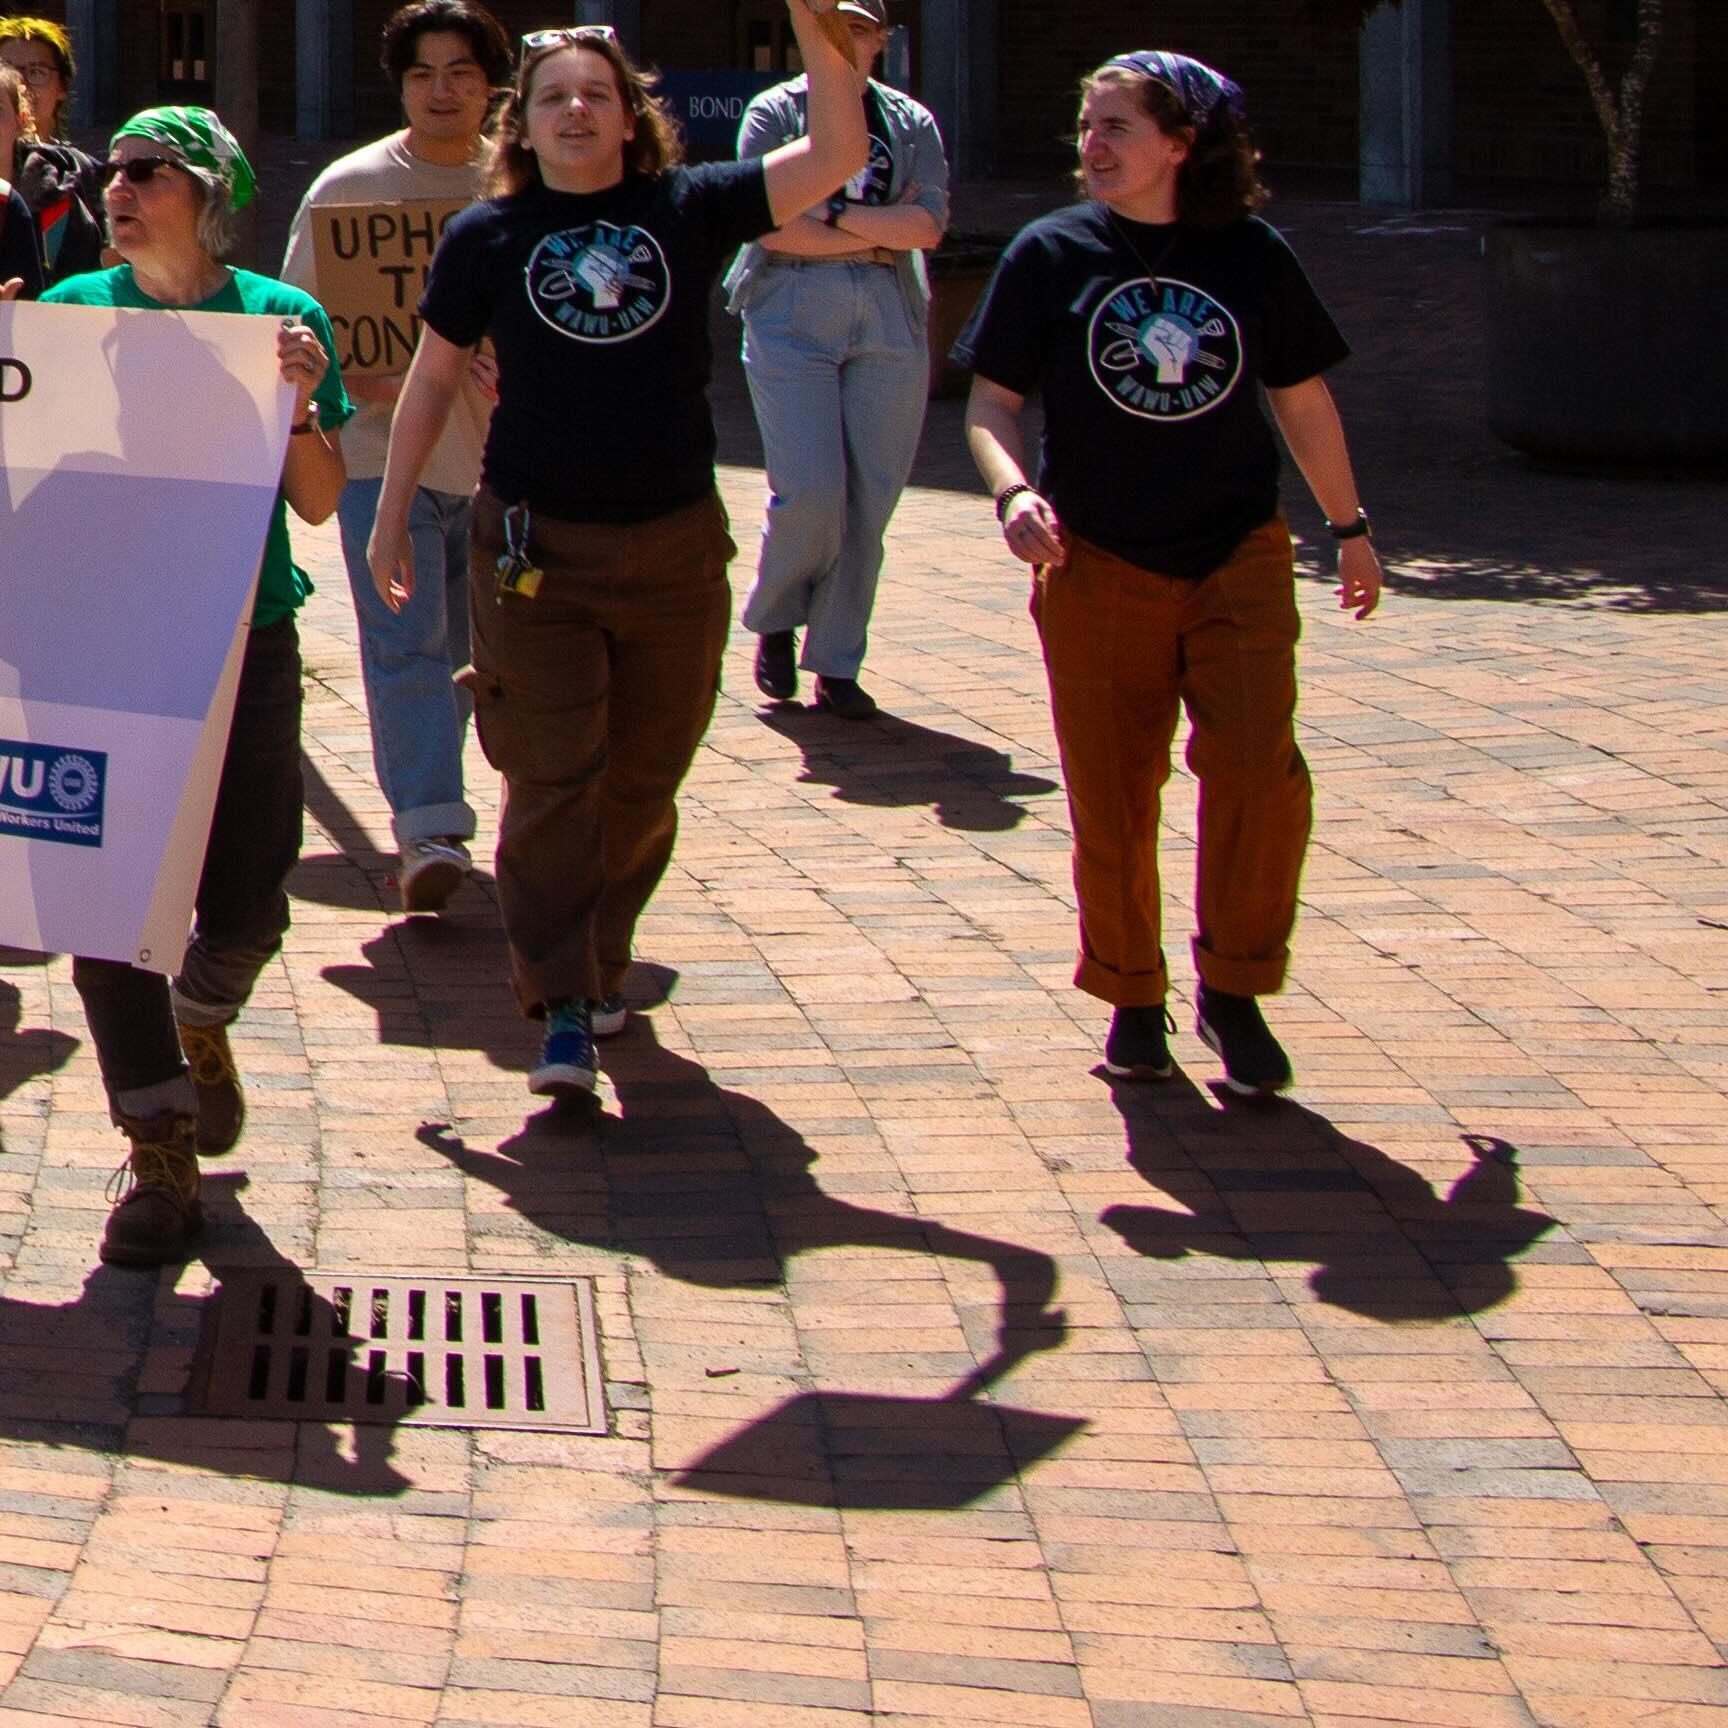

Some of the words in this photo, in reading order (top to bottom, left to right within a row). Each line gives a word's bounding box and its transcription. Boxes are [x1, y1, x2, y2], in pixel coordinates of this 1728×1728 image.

[689, 96, 743, 119] BOND
[1108, 288, 1151, 322] WE
[1162, 287, 1214, 322] ARE
[53, 819, 101, 836] United
